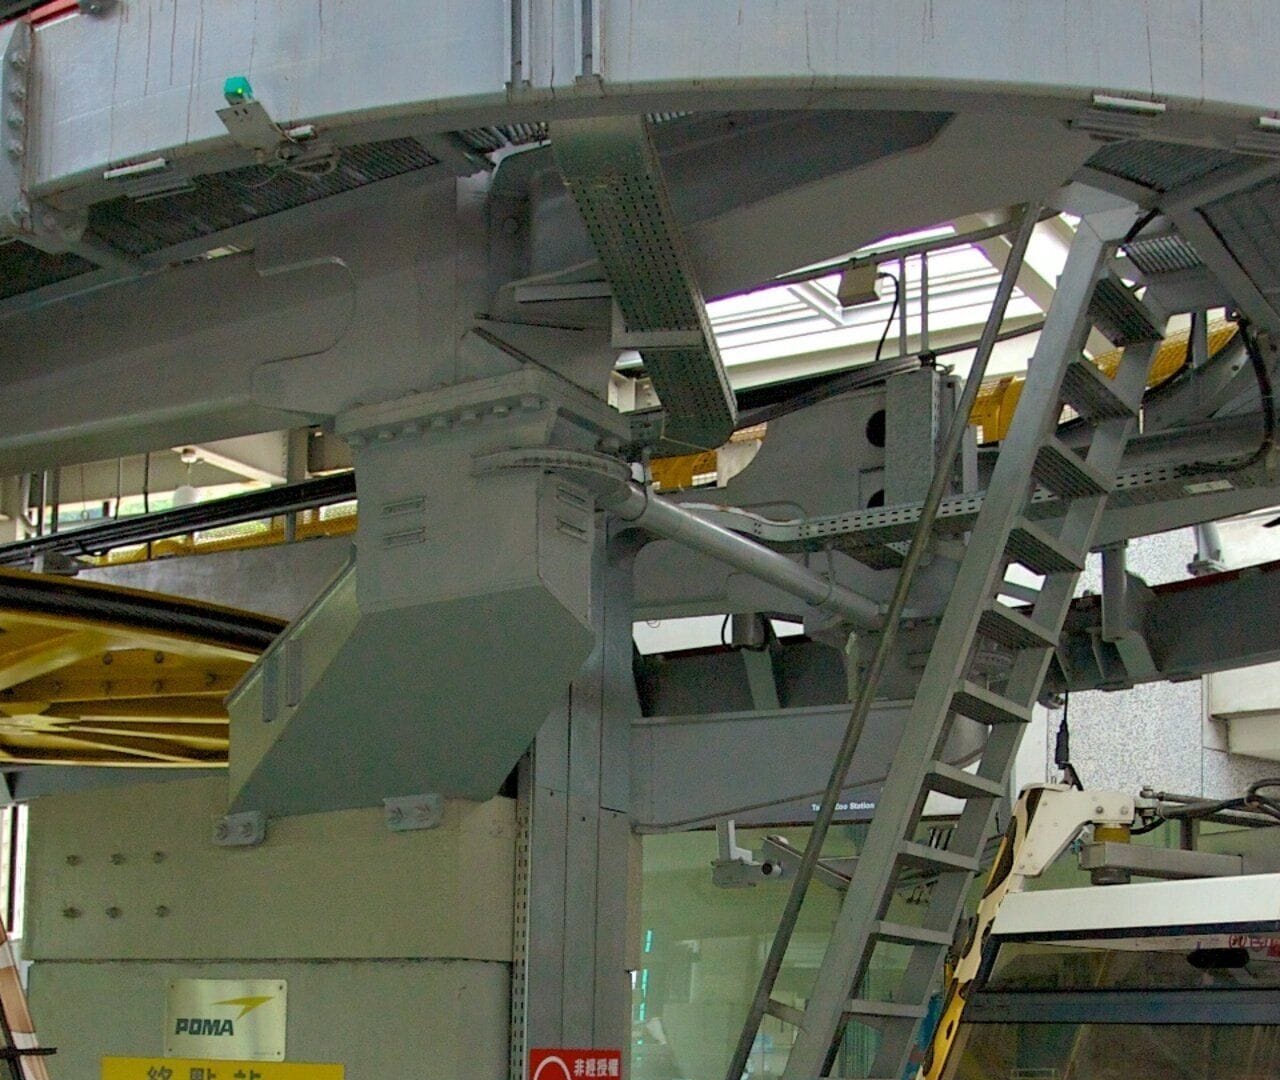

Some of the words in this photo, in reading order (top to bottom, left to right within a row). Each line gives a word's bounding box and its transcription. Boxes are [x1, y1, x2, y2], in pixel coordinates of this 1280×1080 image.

[849, 801, 875, 810] Station
[175, 1018, 234, 1036] POMA
[573, 1058, 619, 1076] 非經授權
